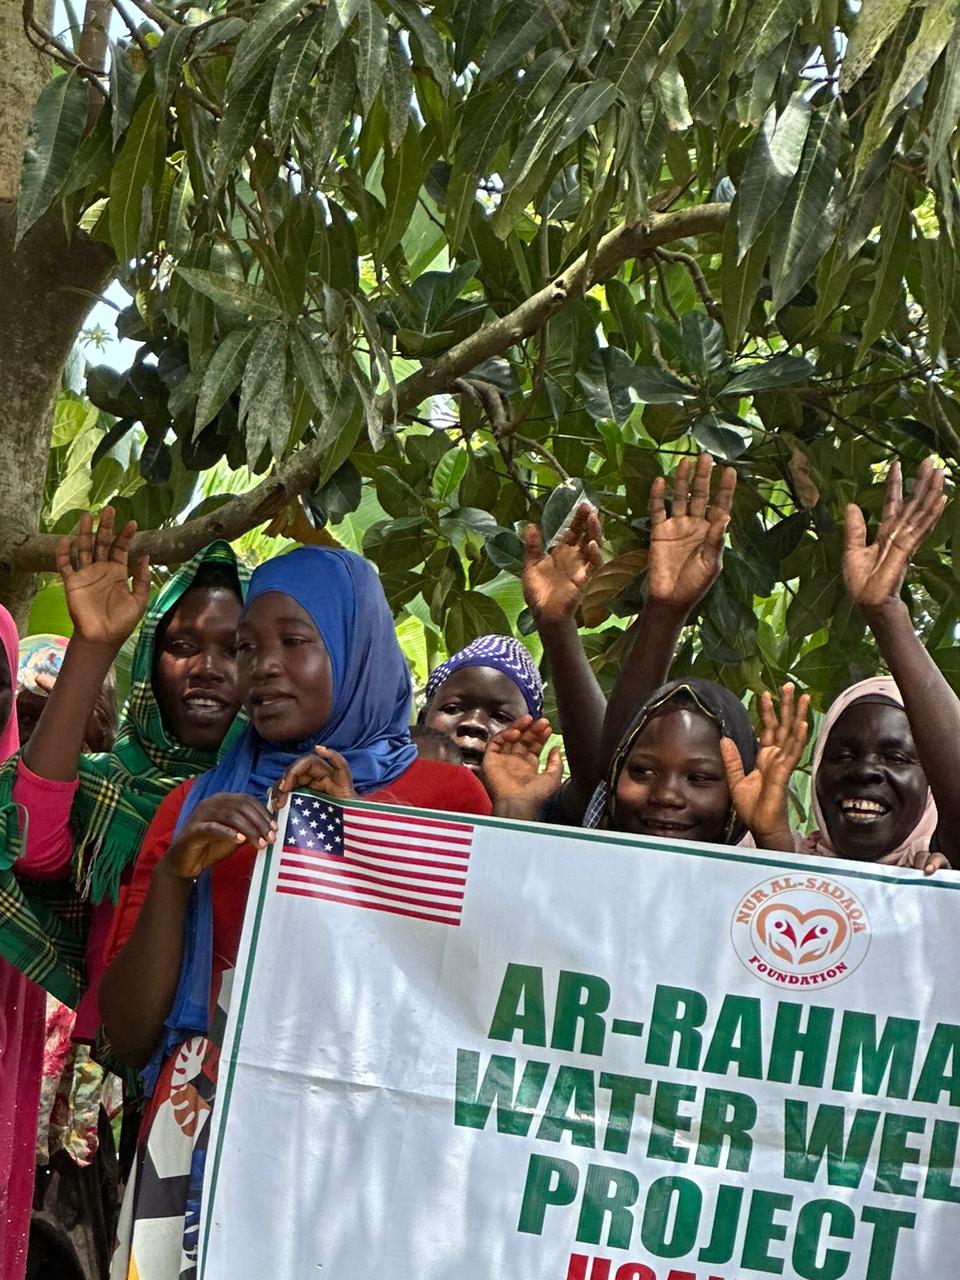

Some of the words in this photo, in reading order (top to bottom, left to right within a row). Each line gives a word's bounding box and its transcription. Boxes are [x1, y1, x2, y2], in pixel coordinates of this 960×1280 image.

[736, 889, 769, 925] NUR
[770, 877, 867, 934] AL-SADAQA
[748, 955, 848, 986] FOUNDATION
[488, 962, 960, 1107] AR-RAHMA
[453, 1049, 759, 1173] WATER
